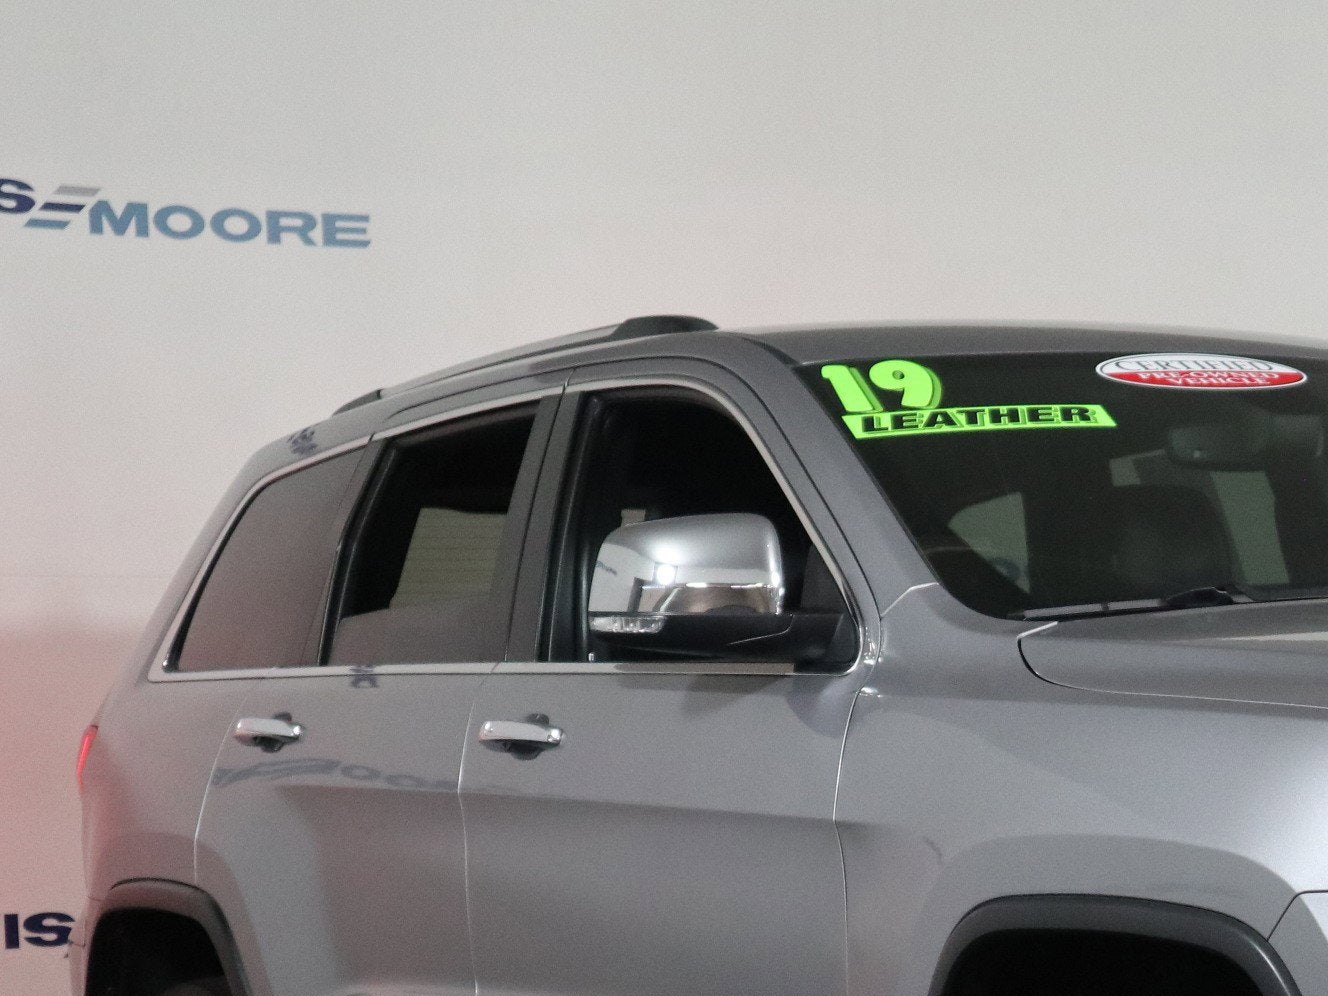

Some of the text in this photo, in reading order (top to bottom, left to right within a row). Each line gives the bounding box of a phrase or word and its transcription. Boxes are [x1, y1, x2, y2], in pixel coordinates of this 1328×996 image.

[89, 199, 371, 248] MOORE
[1115, 360, 1273, 371] CERTIFIED
[821, 359, 941, 413] 19
[861, 406, 1099, 433] LEATHER
